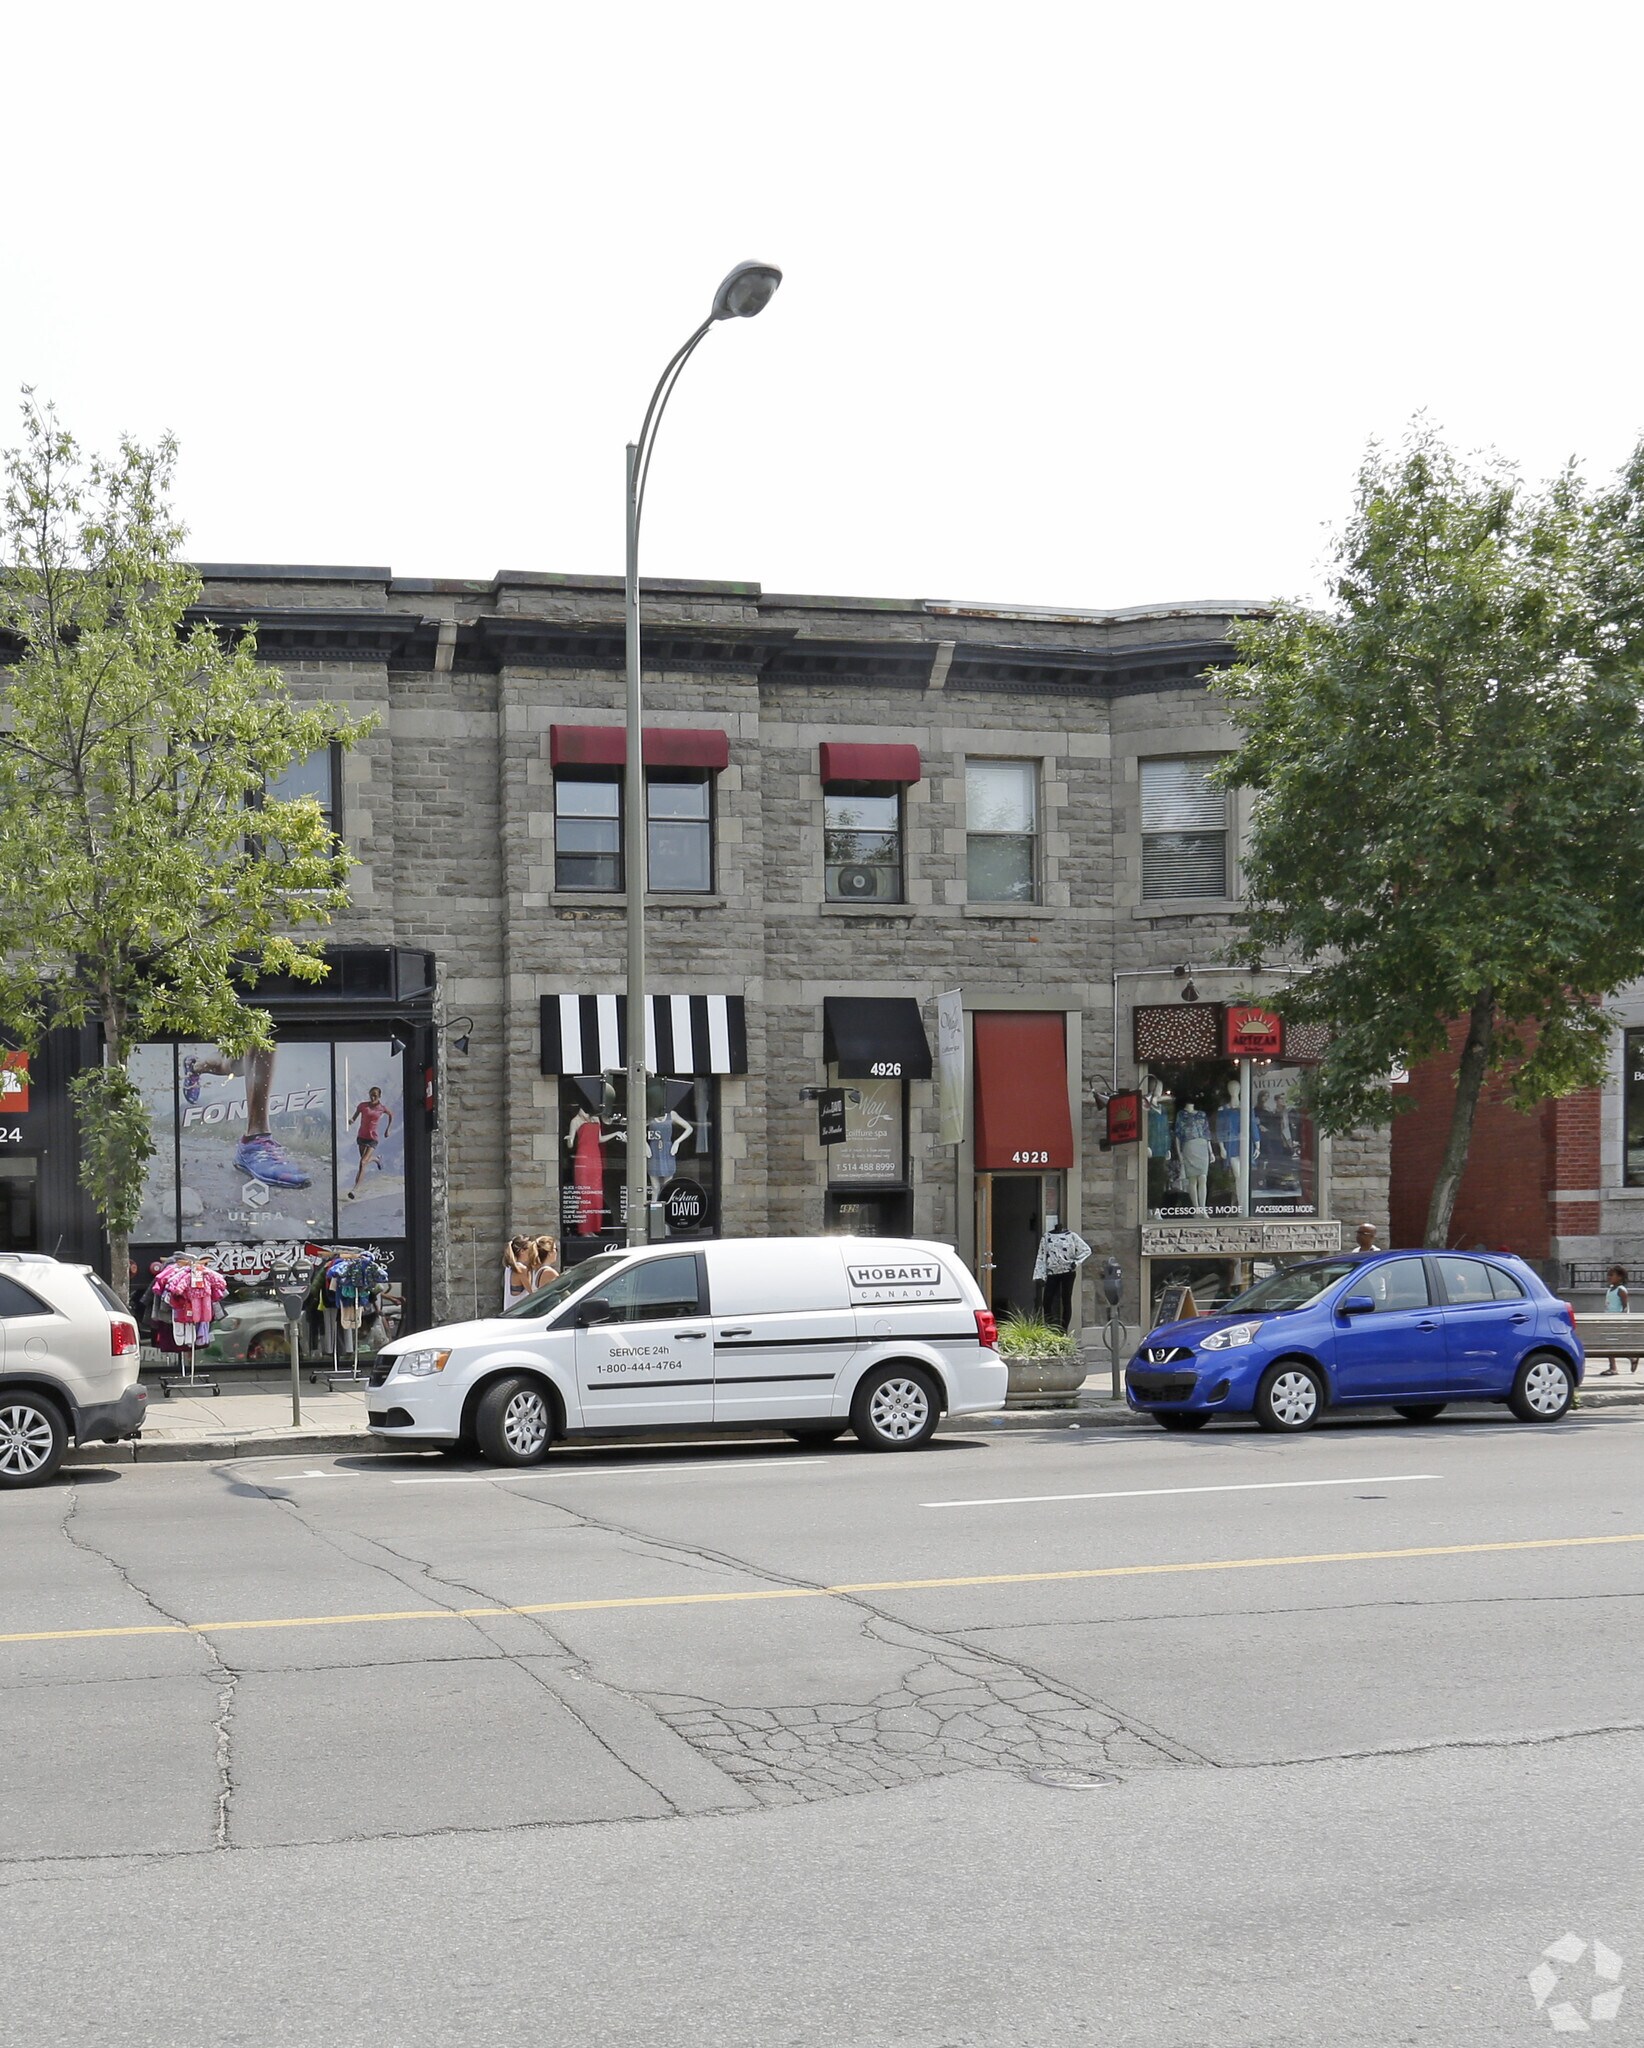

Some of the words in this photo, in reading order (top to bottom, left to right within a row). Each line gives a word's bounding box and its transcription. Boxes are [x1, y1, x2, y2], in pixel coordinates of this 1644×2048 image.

[870, 1062, 901, 1076] 4926
[1012, 1151, 1048, 1164] 4928
[842, 1164, 857, 1172] 514
[858, 1163, 874, 1171] 488
[875, 1163, 895, 1171] 8999
[665, 1187, 699, 1205] Joshua
[671, 1201, 700, 1216] DAVID
[1154, 1206, 1213, 1216] ACCESSOIRES
[1215, 1205, 1243, 1214] MODE
[1255, 1205, 1294, 1213] ACCESSOIRES
[1295, 1205, 1313, 1213] MODE
[228, 1211, 284, 1221] ULTRA
[858, 1268, 932, 1280] HOBART
[861, 1289, 935, 1299] CANADA
[609, 1347, 651, 1358] SERVICE
[652, 1345, 669, 1355] 24h
[597, 1360, 682, 1374] 1-800-444-4764
